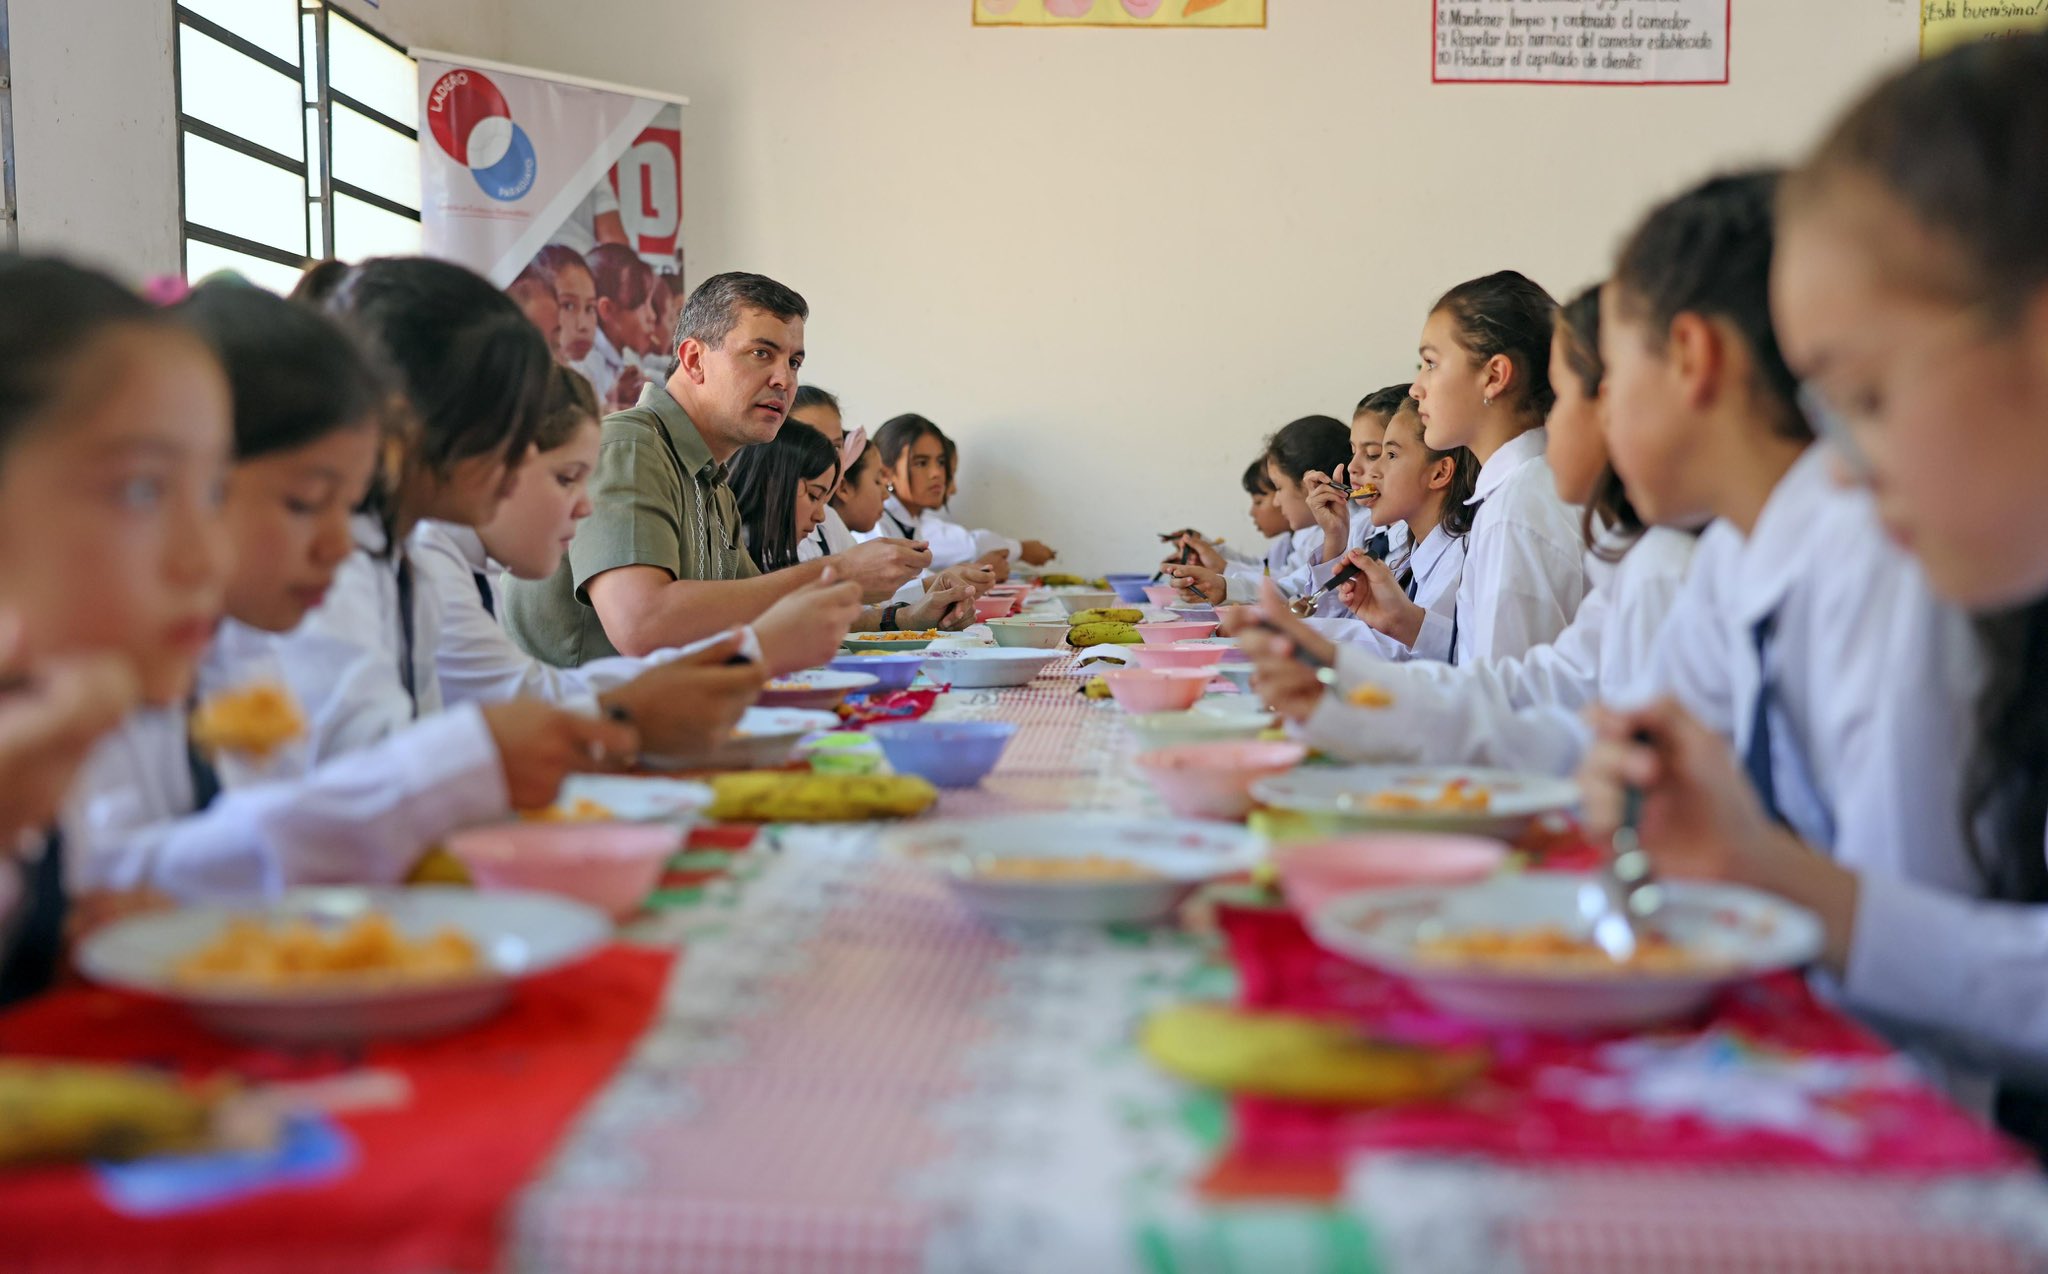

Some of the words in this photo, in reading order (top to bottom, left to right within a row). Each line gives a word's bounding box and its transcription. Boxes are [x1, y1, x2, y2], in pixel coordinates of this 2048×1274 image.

[1448, 8, 1504, 28] Mantener
[1509, 7, 1546, 32] limpio
[1551, 16, 1558, 32] y
[1563, 9, 1616, 29] ordenado
[1622, 9, 1634, 29] el
[1637, 9, 1691, 30] comedor
[1450, 29, 1500, 54] Respetar
[1504, 31, 1525, 48] las
[1527, 35, 1573, 48] normas
[1576, 31, 1595, 48] del
[1597, 32, 1643, 49] comedor
[1646, 30, 1713, 50] establecido
[1453, 48, 1506, 67] Practicar
[1510, 49, 1523, 66] el
[1582, 51, 1598, 69] de
[1601, 50, 1643, 70] dientes
[430, 71, 469, 113] LADERO
